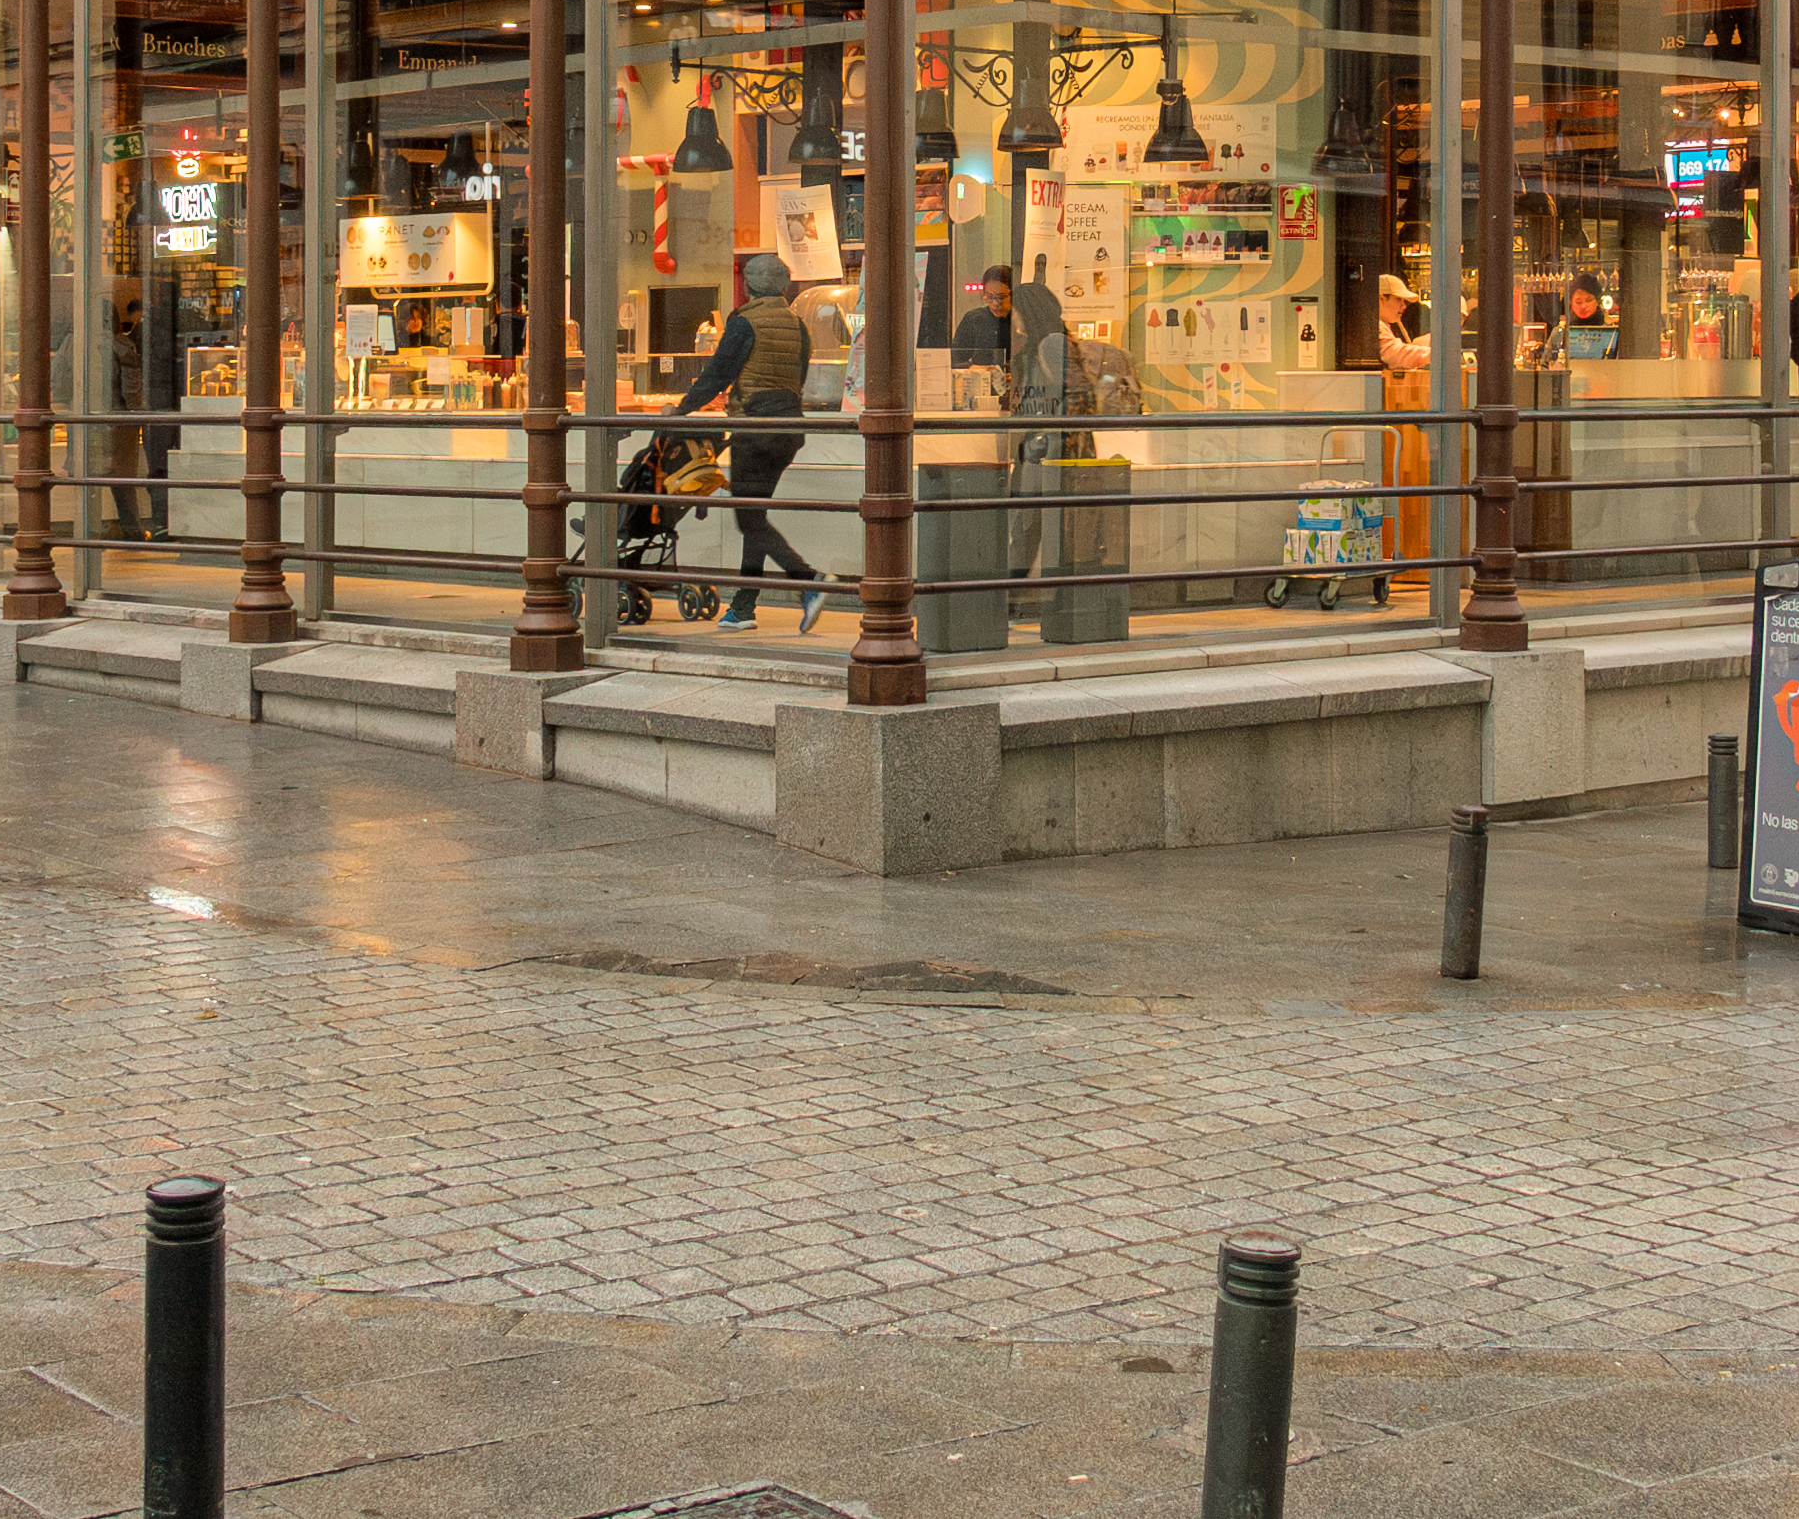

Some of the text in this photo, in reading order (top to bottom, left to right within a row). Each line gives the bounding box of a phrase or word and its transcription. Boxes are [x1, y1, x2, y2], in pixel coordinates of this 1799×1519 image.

[143, 33, 226, 59] Brioches
[1679, 159, 1704, 176] 669
[1031, 179, 1066, 208] EXTRA
[379, 224, 415, 236] PANET
[1280, 227, 1314, 235] EXTINTOR
[1771, 615, 1786, 627] su
[1762, 811, 1779, 828] No
[1781, 814, 1798, 831] las
